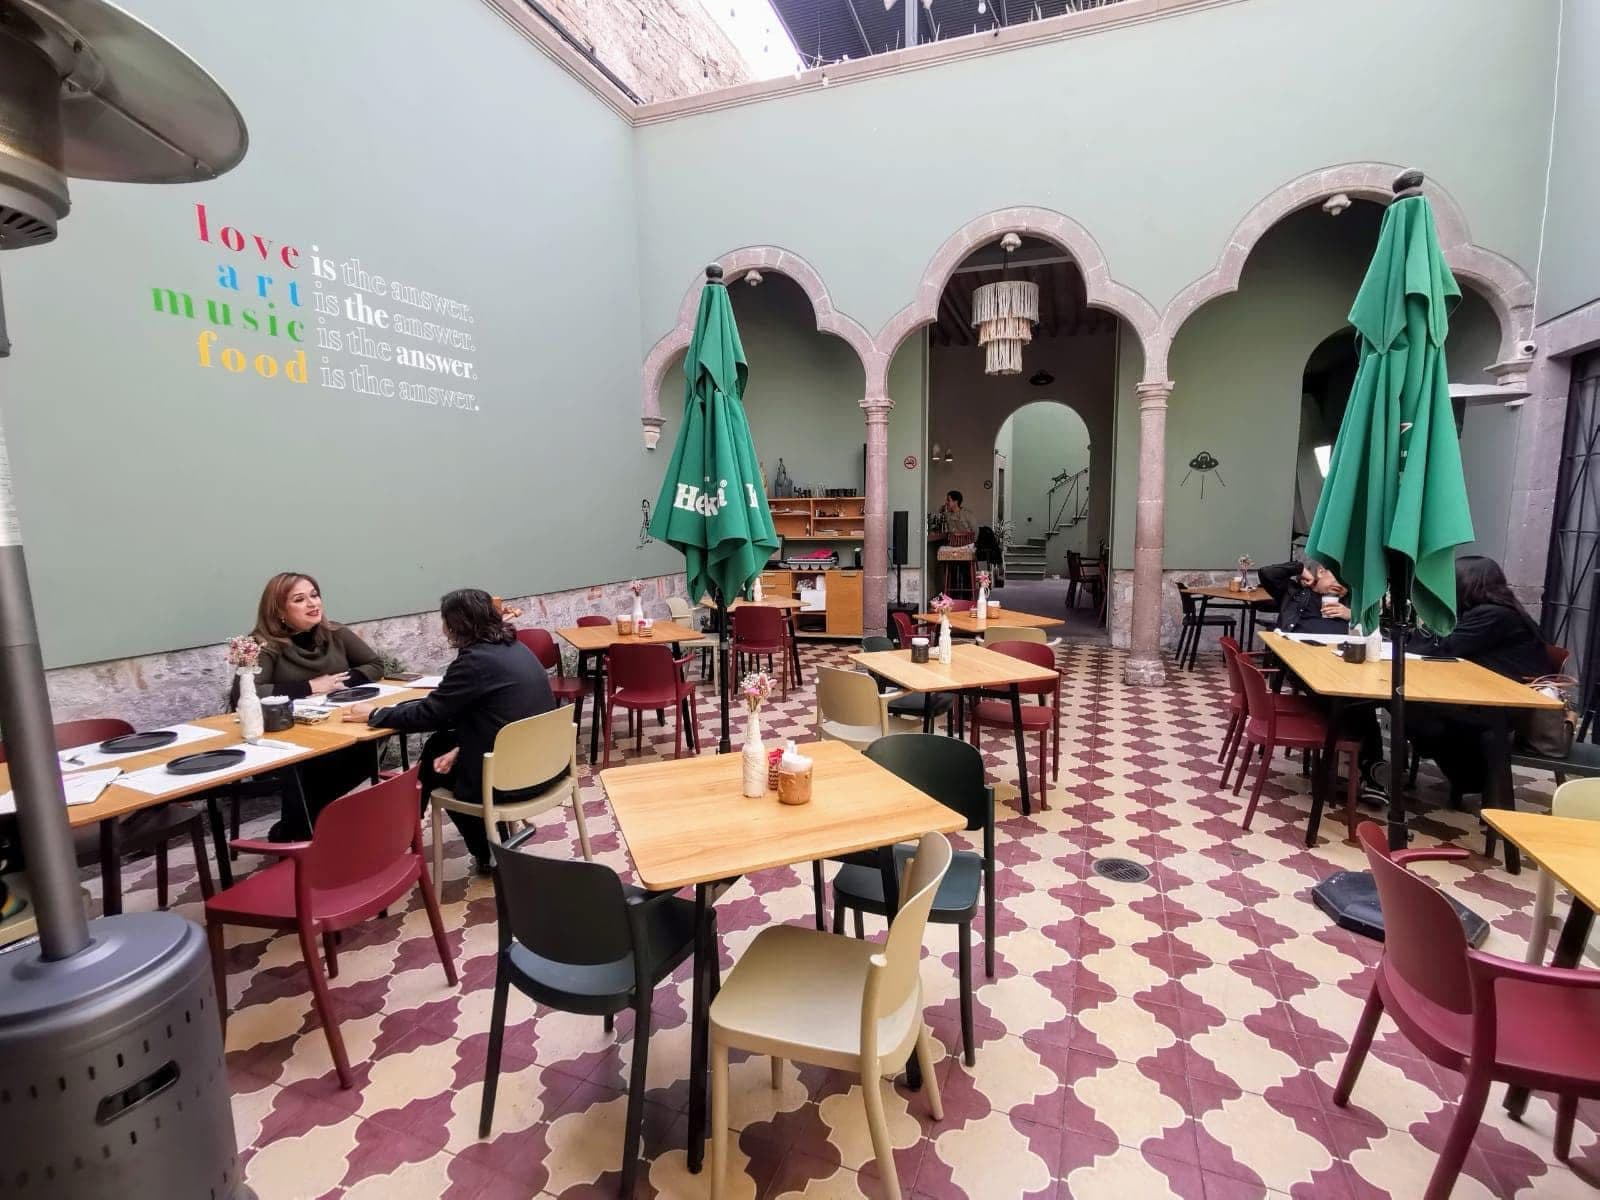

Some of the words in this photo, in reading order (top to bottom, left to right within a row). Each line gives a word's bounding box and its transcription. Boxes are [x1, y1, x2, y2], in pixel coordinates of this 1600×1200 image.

[193, 202, 299, 270] love
[310, 244, 337, 281] is
[340, 257, 388, 297] the
[390, 281, 475, 324] answer.
[216, 264, 303, 308] art
[312, 280, 340, 317] is
[344, 292, 390, 329] the
[393, 313, 477, 352] answer.
[151, 287, 305, 342] music
[316, 317, 343, 352] is
[346, 326, 392, 362] the
[395, 345, 479, 381] answer.
[196, 329, 308, 385] food
[319, 356, 346, 390] is
[349, 364, 396, 398] the
[398, 380, 480, 412] answer.
